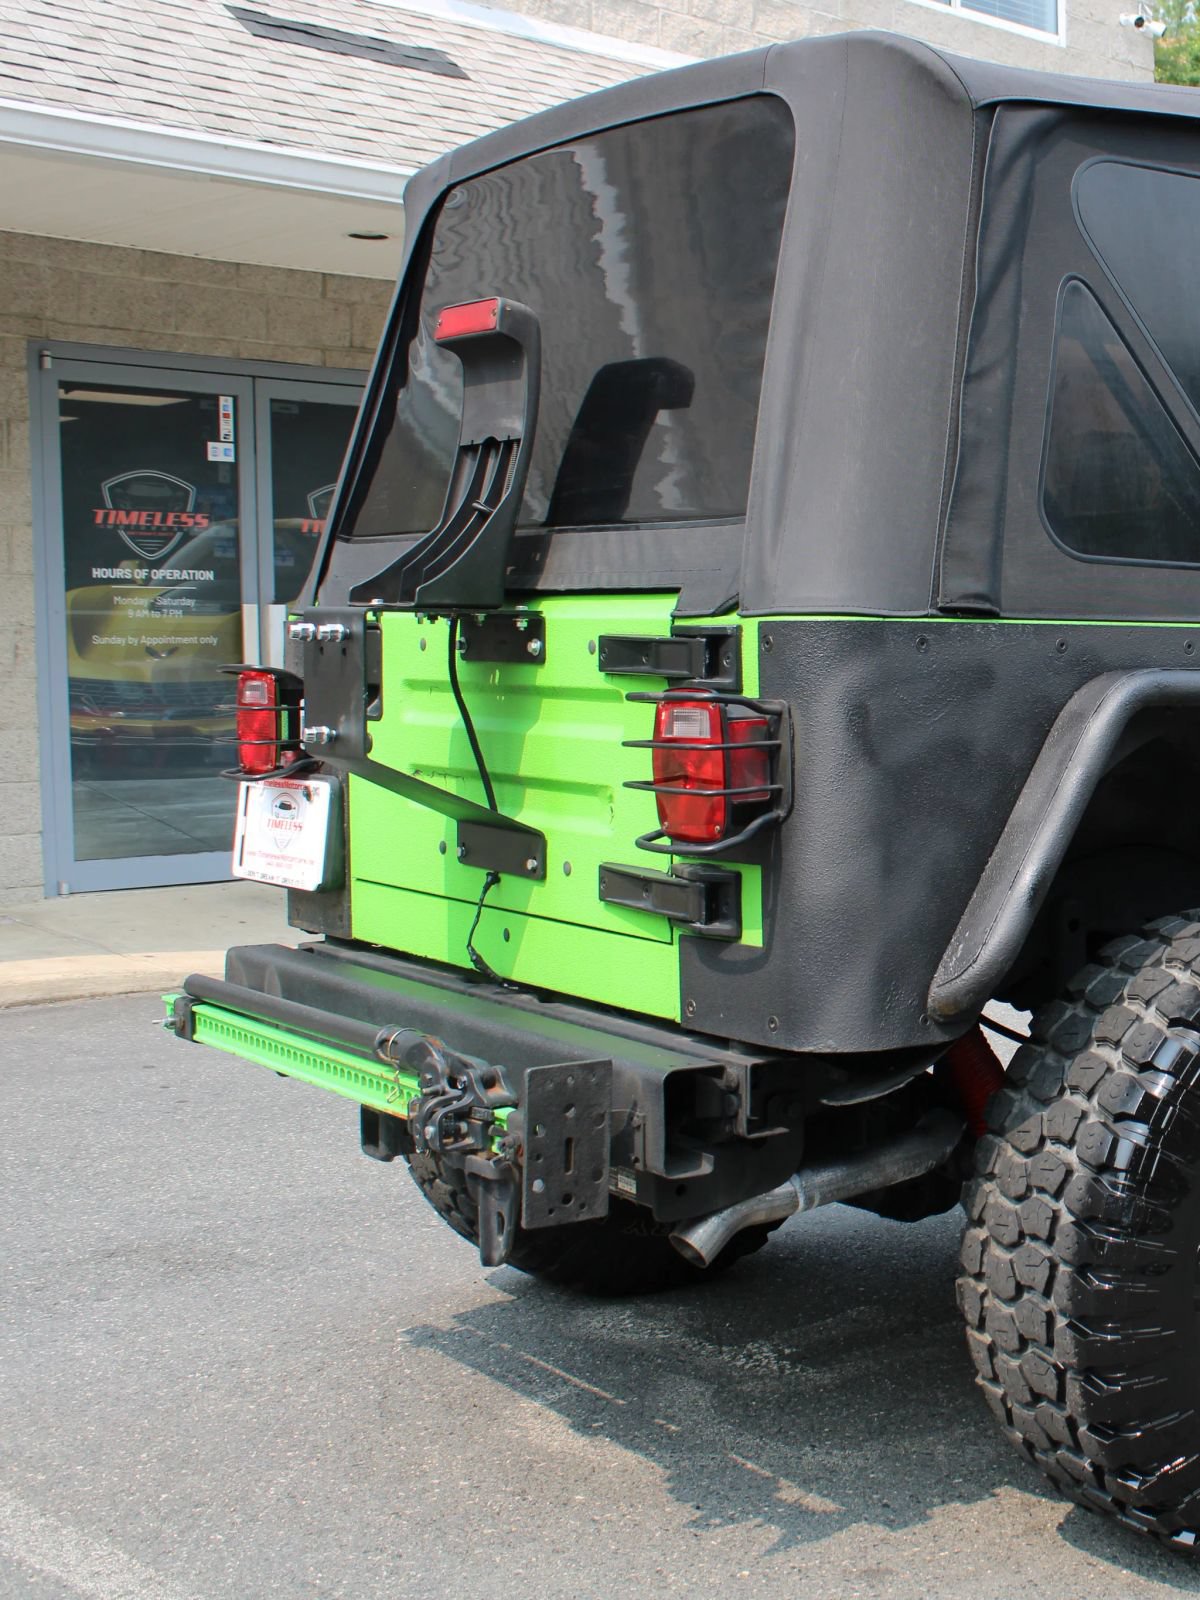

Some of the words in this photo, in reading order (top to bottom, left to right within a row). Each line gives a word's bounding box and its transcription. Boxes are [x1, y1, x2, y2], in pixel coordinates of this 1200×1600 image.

[92, 509, 209, 527] TIMELESS
[92, 567, 132, 579] HOURS
[134, 568, 149, 579] OF
[151, 568, 214, 580] OPERATION
[113, 596, 148, 607] Monday
[156, 596, 195, 608] Saturday
[128, 609, 134, 618] 9
[135, 609, 149, 618] AM
[151, 610, 161, 618] to
[162, 610, 167, 618] 7
[169, 609, 183, 618] PM
[92, 635, 126, 646] Sunday
[127, 635, 138, 646] by
[140, 635, 198, 645] Appointment
[199, 635, 218, 646] only
